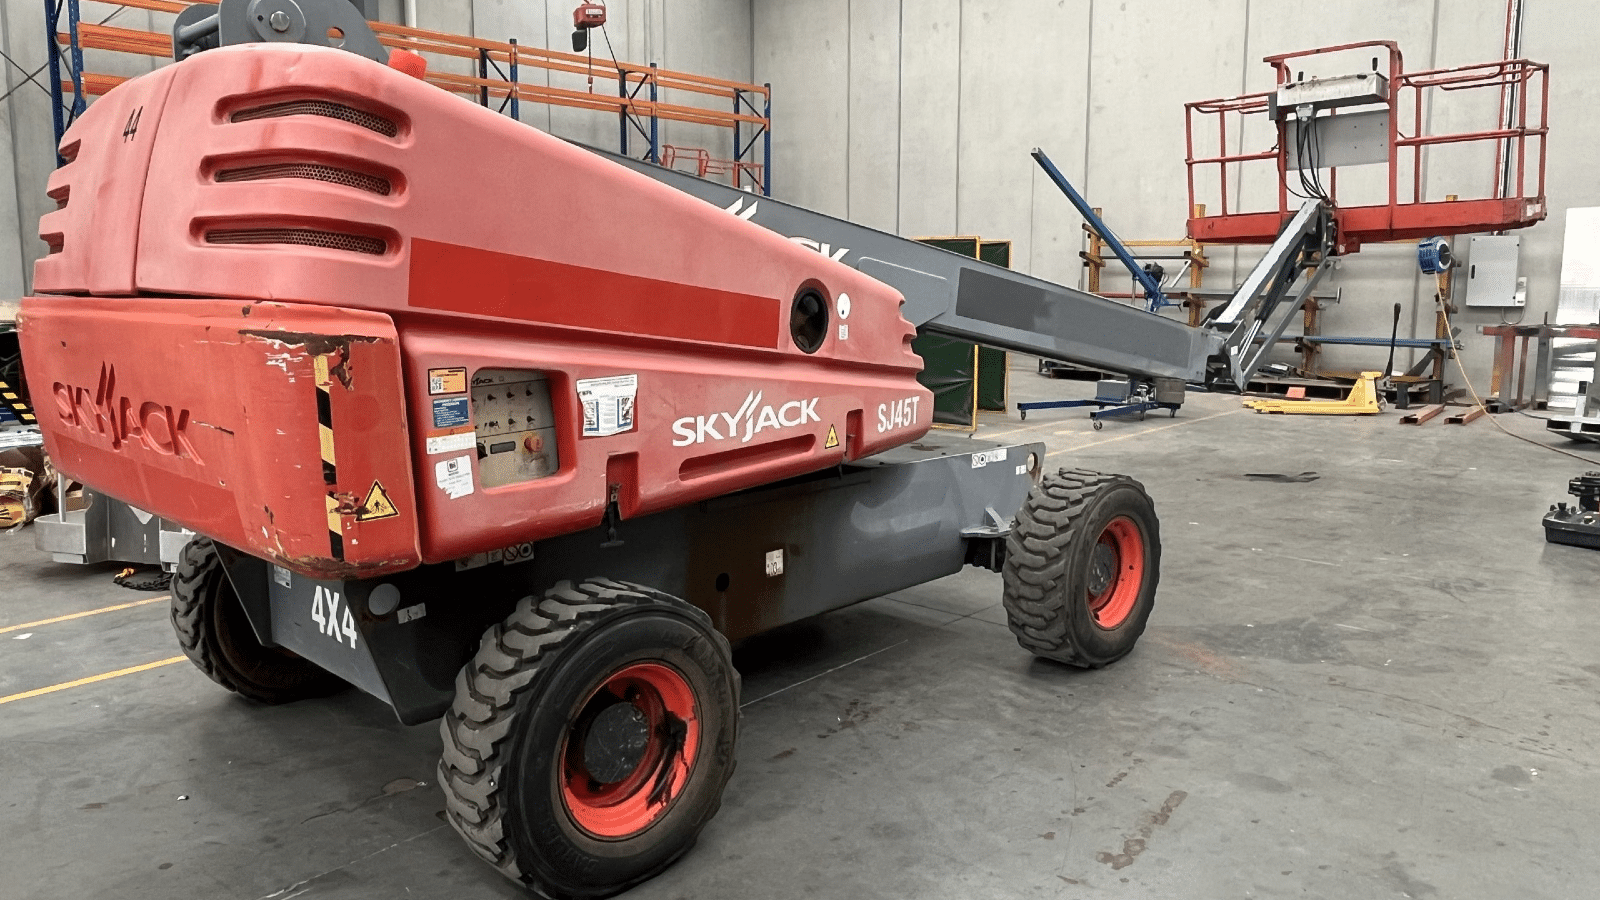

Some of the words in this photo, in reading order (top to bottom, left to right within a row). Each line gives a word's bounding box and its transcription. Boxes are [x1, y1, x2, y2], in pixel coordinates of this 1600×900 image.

[123, 106, 143, 143] 44
[53, 361, 204, 466] SKYJACK
[673, 390, 821, 446] SKYJACK
[877, 396, 919, 433] SJ45T
[311, 585, 357, 649] 4X4
